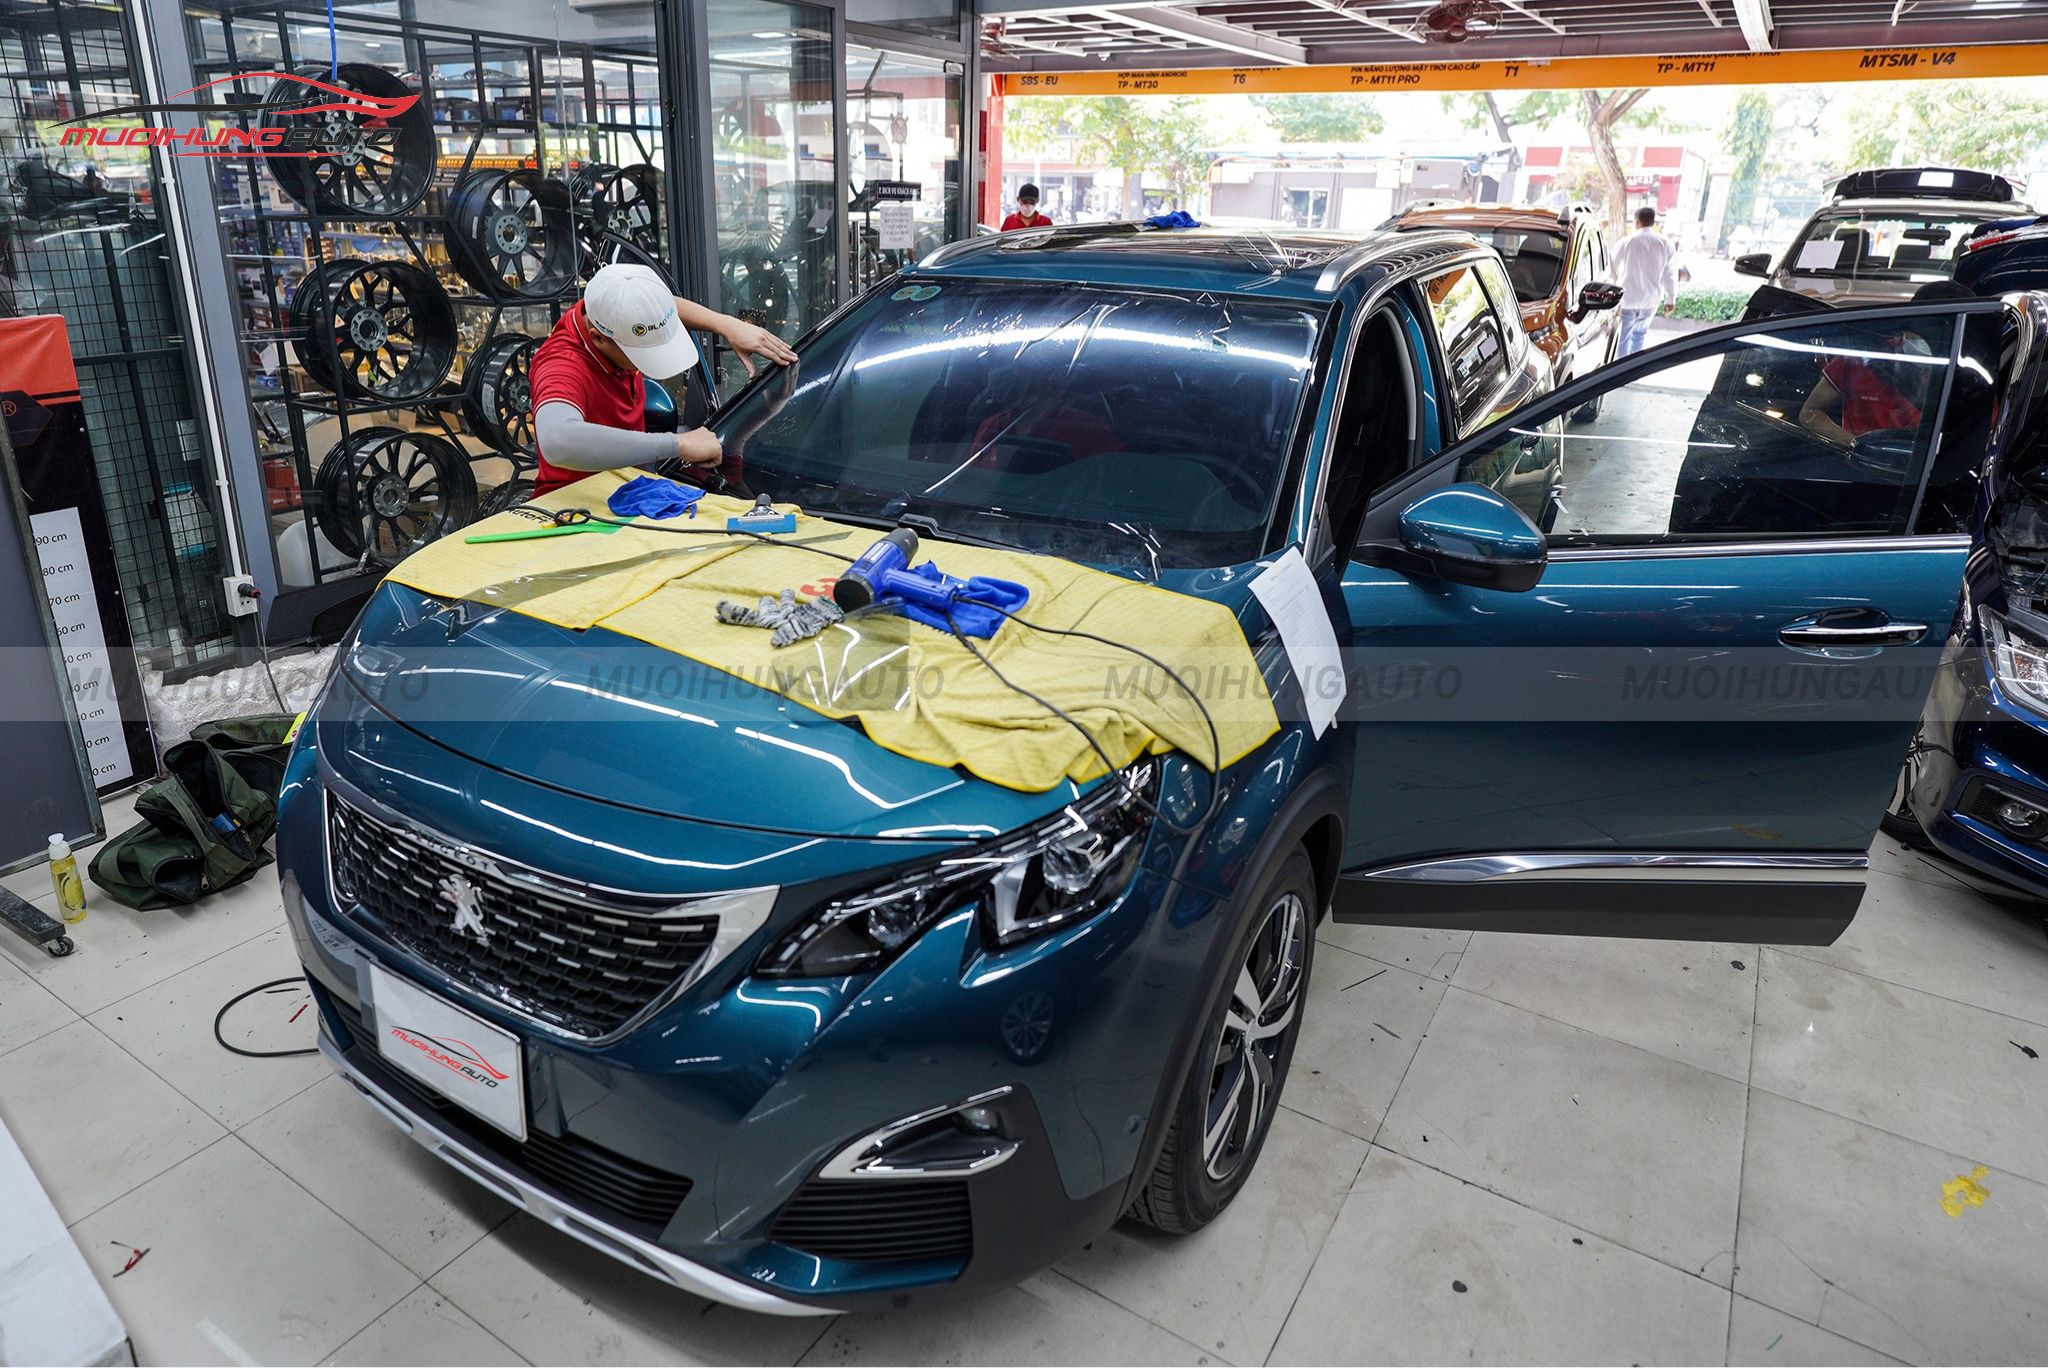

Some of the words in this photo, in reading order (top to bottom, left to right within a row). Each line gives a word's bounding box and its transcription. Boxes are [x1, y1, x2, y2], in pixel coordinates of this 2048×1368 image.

[1859, 53, 1918, 68] MTSM
[1932, 51, 1956, 65] V4
[1505, 65, 1519, 77] T1
[1657, 63, 1674, 73] TP
[1681, 62, 1716, 73] MT11
[1021, 75, 1039, 86] SBS
[1045, 75, 1058, 86] EU
[1233, 73, 1246, 84] T6
[1351, 75, 1363, 85] TP
[1370, 75, 1396, 84] MT11
[1397, 74, 1420, 84] PRO
[1118, 81, 1128, 89] TP
[1134, 80, 1158, 89] MT30
[35, 535, 49, 545] 90
[51, 533, 68, 543] cm
[42, 566, 56, 576] 80
[57, 563, 74, 573] cm
[49, 596, 62, 606] 70
[64, 593, 80, 603] cm
[70, 622, 86, 632] cm
[63, 655, 74, 664] 0
[76, 651, 92, 661] cm
[83, 680, 99, 690] cm
[89, 708, 105, 718] cm
[94, 735, 110, 745] cm
[100, 763, 116, 773] cm
[391, 1029, 498, 1088] MUOIHUNGAUTO
